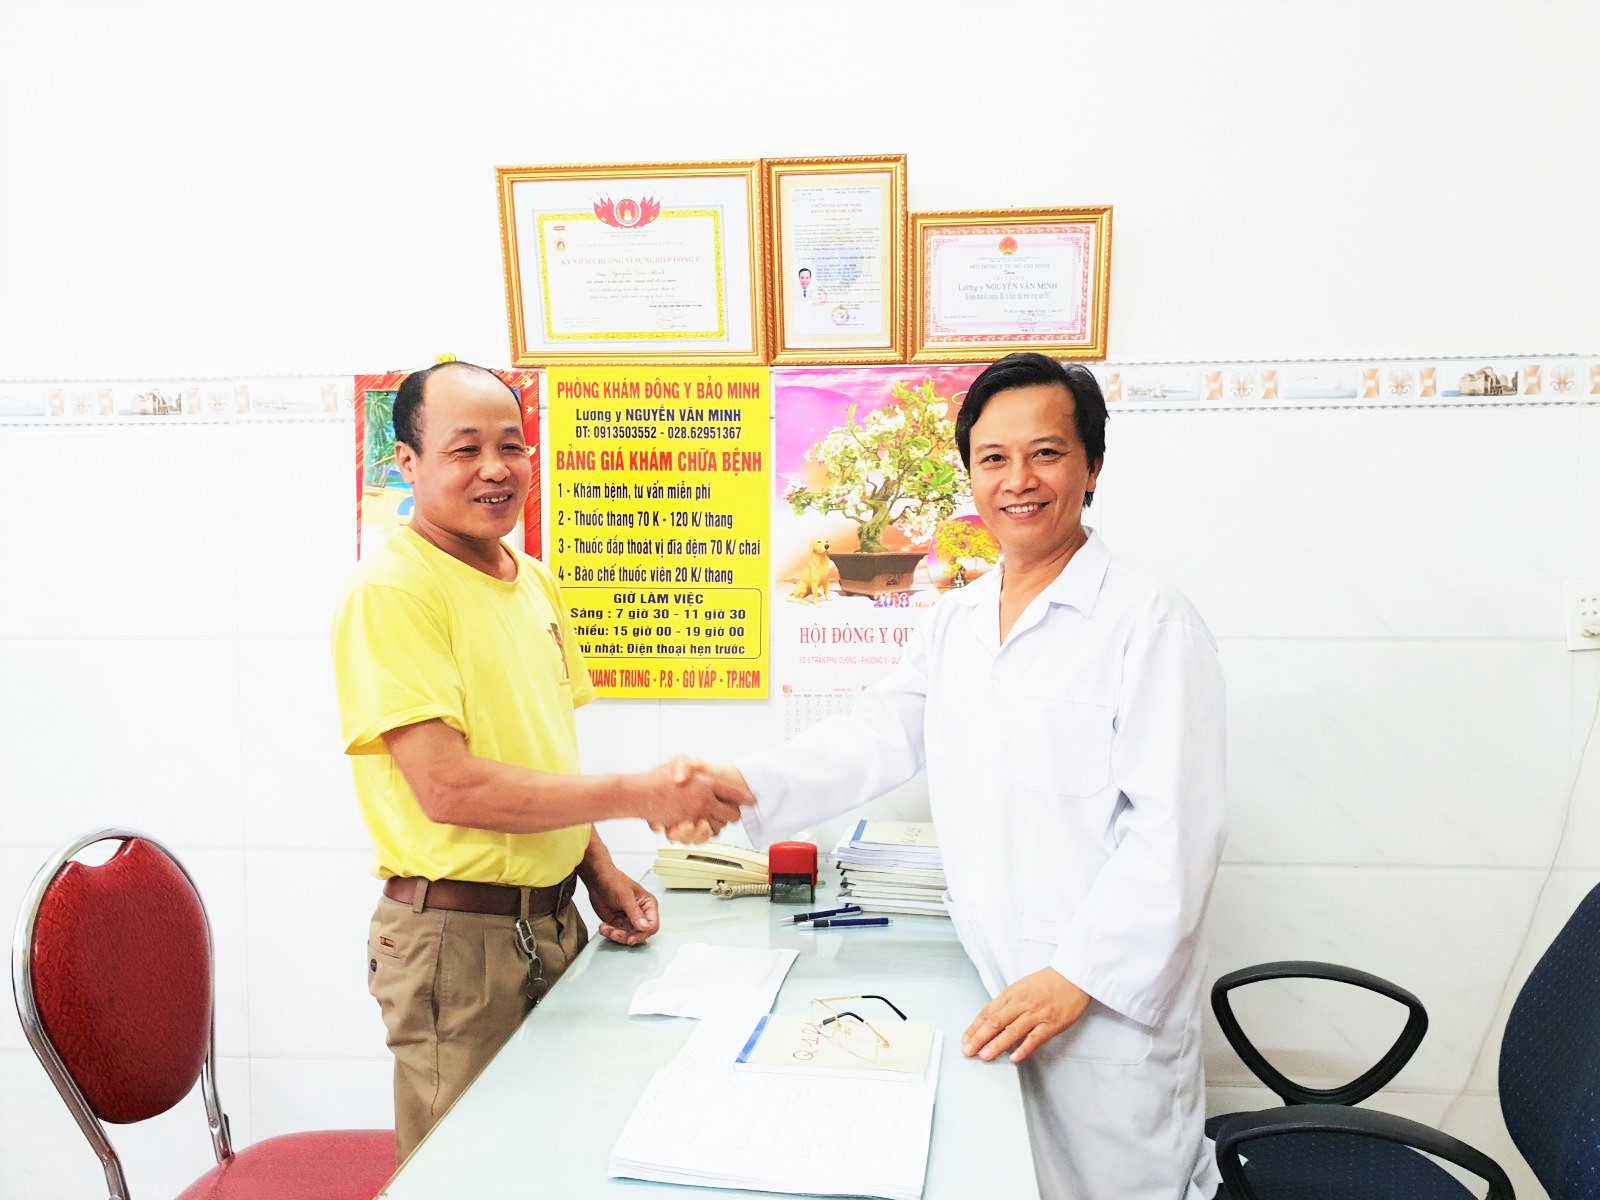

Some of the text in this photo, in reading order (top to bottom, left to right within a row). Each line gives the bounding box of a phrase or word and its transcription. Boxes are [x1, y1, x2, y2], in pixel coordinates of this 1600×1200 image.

[557, 375, 760, 399] PHÒNG KHÁM ĐÔNG Y BẢO MINH
[576, 404, 741, 422] Lương y NGUYỄN VĂN MINH
[576, 425, 590, 438] ĐT:
[594, 426, 657, 438] 0913503552
[667, 427, 742, 438] 028.62951367
[556, 443, 762, 477] BẢNG GIÁ KHÁM CHỮA BỆNH
[558, 482, 562, 497] 1
[573, 482, 601, 498] Khám
[604, 482, 631, 502] bệnh,
[634, 483, 643, 498] tư
[647, 480, 664, 499] vấn
[667, 480, 692, 499] miễn
[695, 483, 711, 501] phí
[558, 510, 564, 525] 2
[574, 507, 603, 526] Thuốc
[606, 510, 634, 528] thang
[637, 511, 649, 526] 70
[652, 511, 659, 526] K
[670, 511, 688, 526] 120
[691, 511, 702, 527] K/
[705, 512, 733, 529] thang
[558, 538, 564, 553] 3
[574, 535, 603, 554] Thuốc
[606, 534, 624, 556] đắp
[627, 538, 652, 554] thoát
[655, 538, 664, 558] vị
[667, 538, 682, 554] đĩa
[686, 538, 707, 558] đệm
[710, 539, 723, 554] 70
[726, 539, 737, 555] K/
[739, 539, 761, 555] chai
[558, 565, 564, 581] 4
[597, 563, 616, 581] chế
[619, 563, 647, 582] thuốc
[650, 566, 672, 582] viên
[675, 567, 687, 582] 20
[691, 566, 702, 582] K/
[705, 567, 733, 584] thang
[613, 590, 704, 606] GIỜ LÀM VIỆC
[873, 592, 910, 609] 2018
[570, 607, 603, 620] Sáng
[607, 610, 611, 619] :
[615, 608, 624, 619] 7
[628, 608, 649, 620] giờ
[653, 609, 669, 619] 30
[684, 609, 698, 619] 11
[704, 609, 725, 620] giờ
[729, 609, 746, 619] 30
[613, 626, 628, 636] 15
[633, 625, 652, 637] giờ
[656, 626, 671, 636] 00
[685, 626, 701, 637] 19
[705, 626, 725, 637] giờ
[729, 626, 745, 637] 00
[799, 622, 826, 648] HỘI
[831, 622, 874, 645] ĐÔNG
[878, 627, 889, 644] Y
[595, 642, 623, 655] nhật:
[627, 642, 653, 656] Điện
[656, 643, 686, 656] thoại
[690, 643, 711, 656] hẹn
[715, 643, 745, 654] trước
[620, 669, 650, 688] TRUNG
[659, 669, 673, 688] P.8
[682, 665, 695, 688] GÒ
[698, 663, 717, 688] VẤP
[726, 670, 761, 688] TP.HCM
